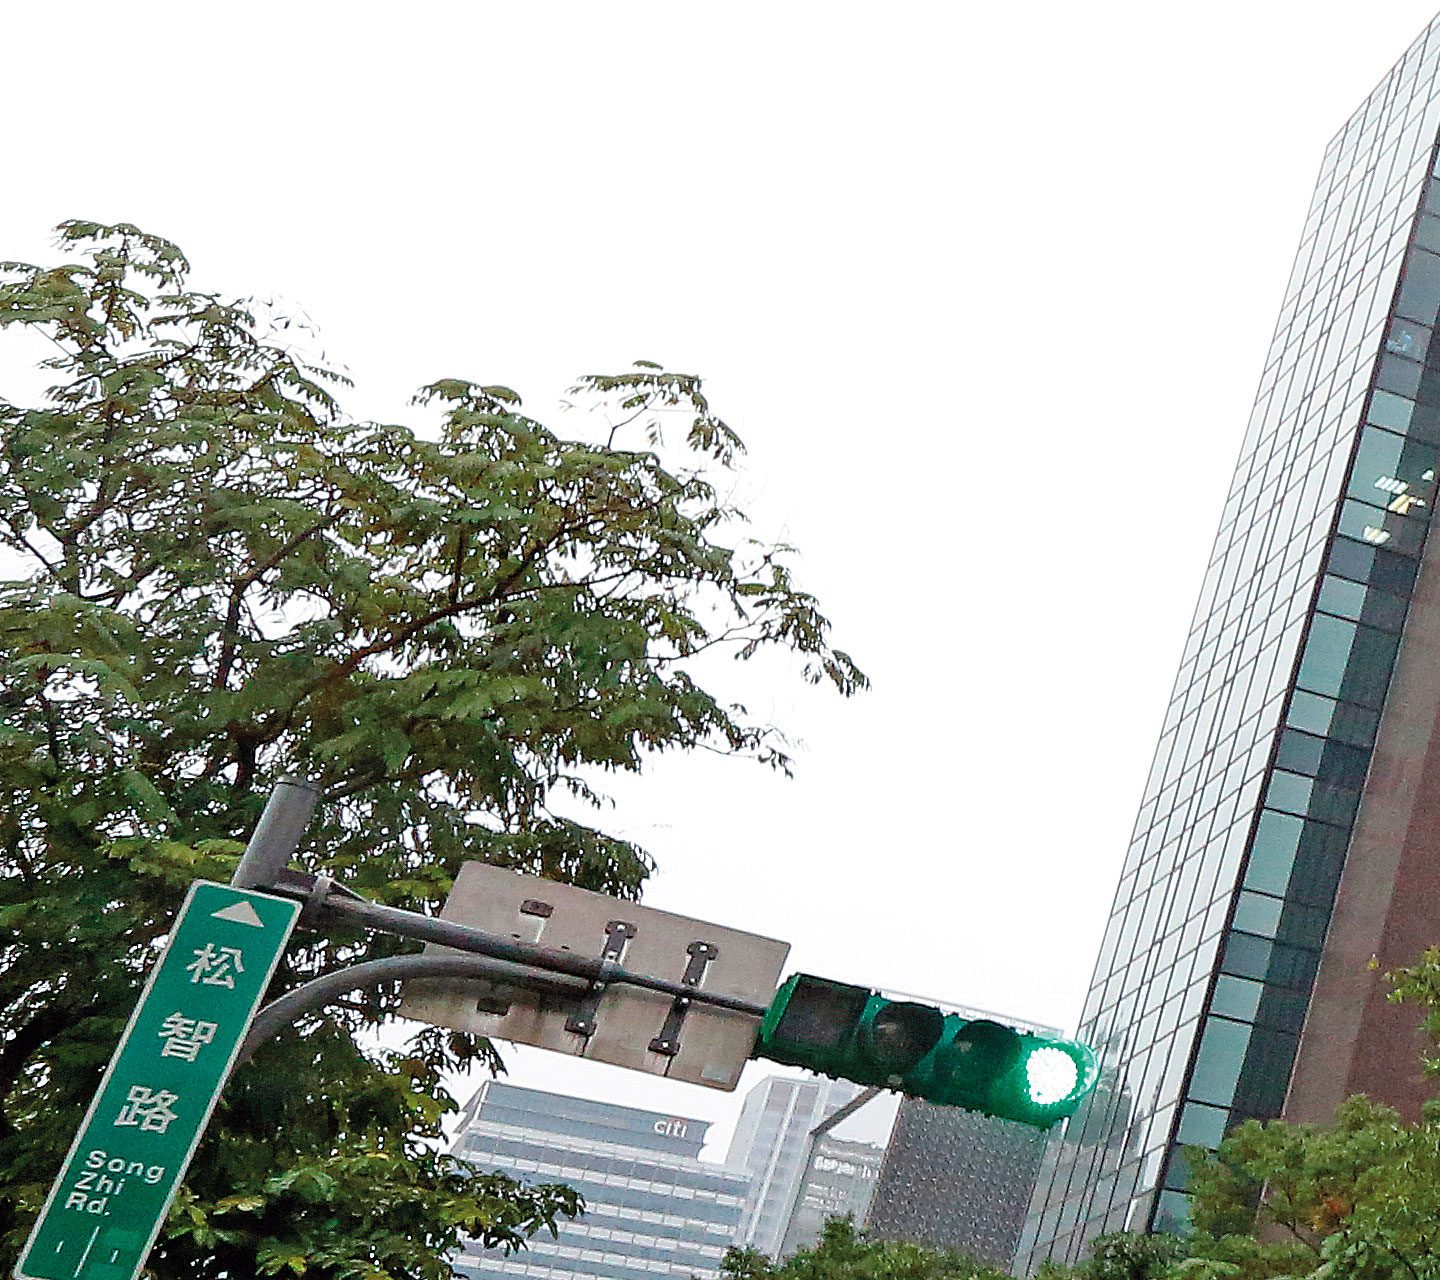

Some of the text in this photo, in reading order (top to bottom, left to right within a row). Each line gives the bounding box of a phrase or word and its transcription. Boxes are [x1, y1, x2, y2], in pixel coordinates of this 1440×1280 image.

[113, 942, 245, 1135] 松智路
[653, 1119, 688, 1138] citi
[85, 1150, 165, 1185] Song
[74, 1171, 124, 1196] Zhi
[65, 1192, 111, 1217] Rd.
